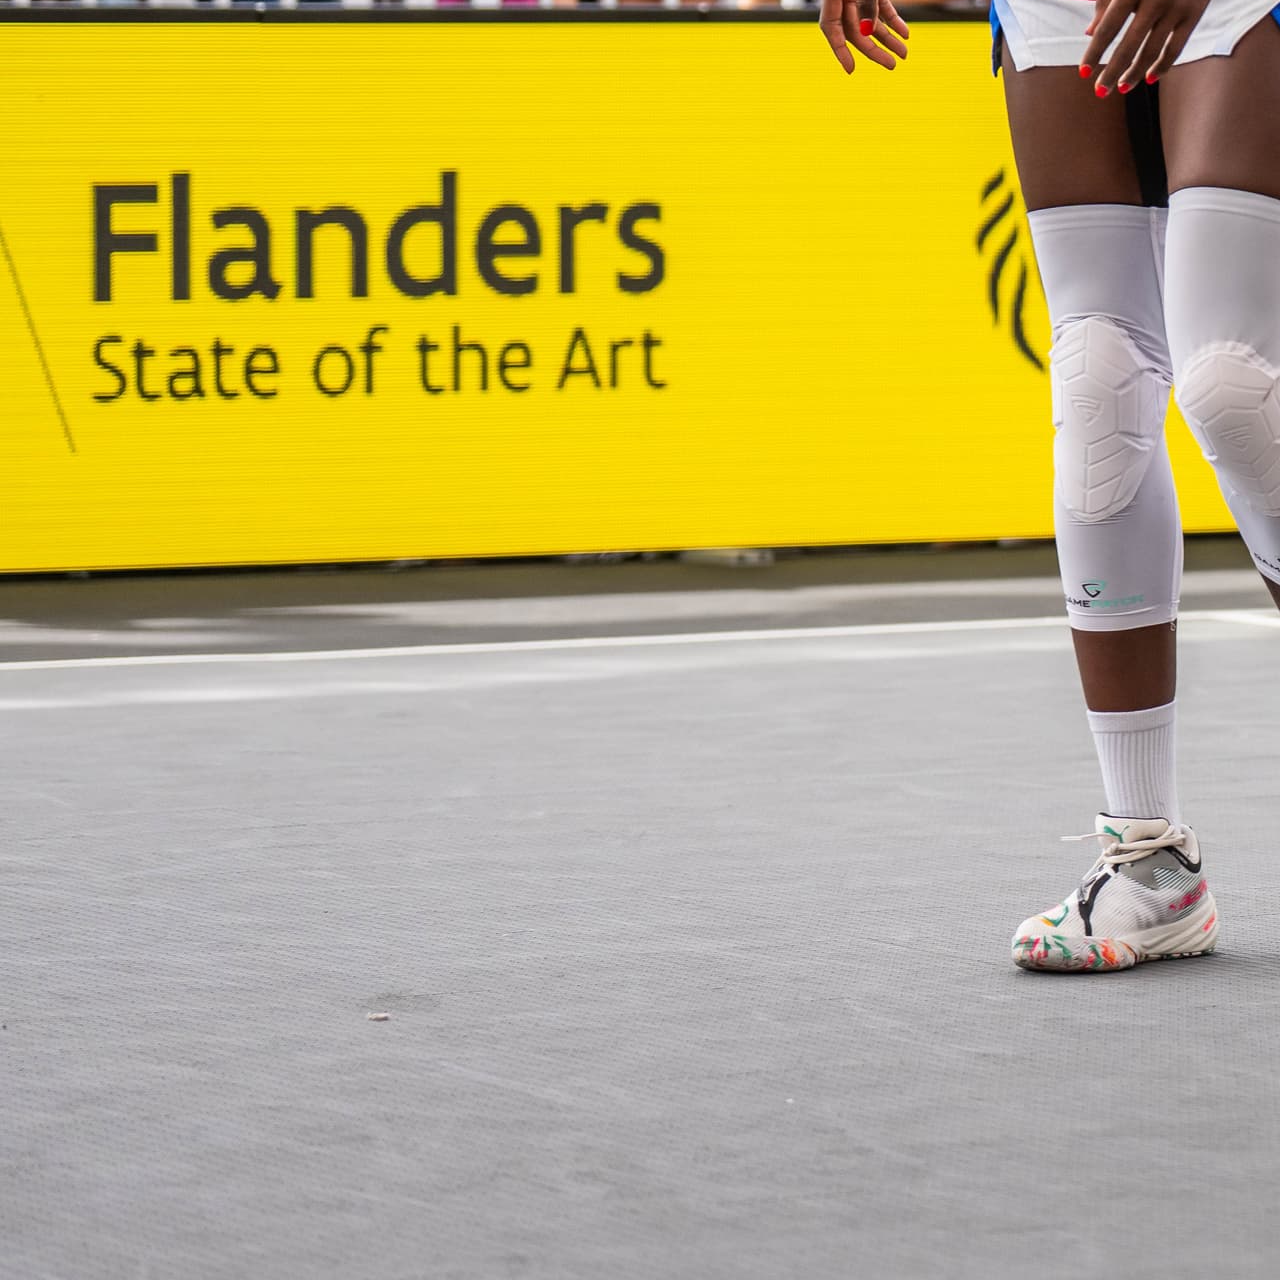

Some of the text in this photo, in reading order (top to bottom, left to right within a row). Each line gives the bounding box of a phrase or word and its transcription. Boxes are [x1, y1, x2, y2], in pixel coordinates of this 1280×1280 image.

[92, 169, 666, 303] Flanders
[93, 323, 668, 404] State of the Art
